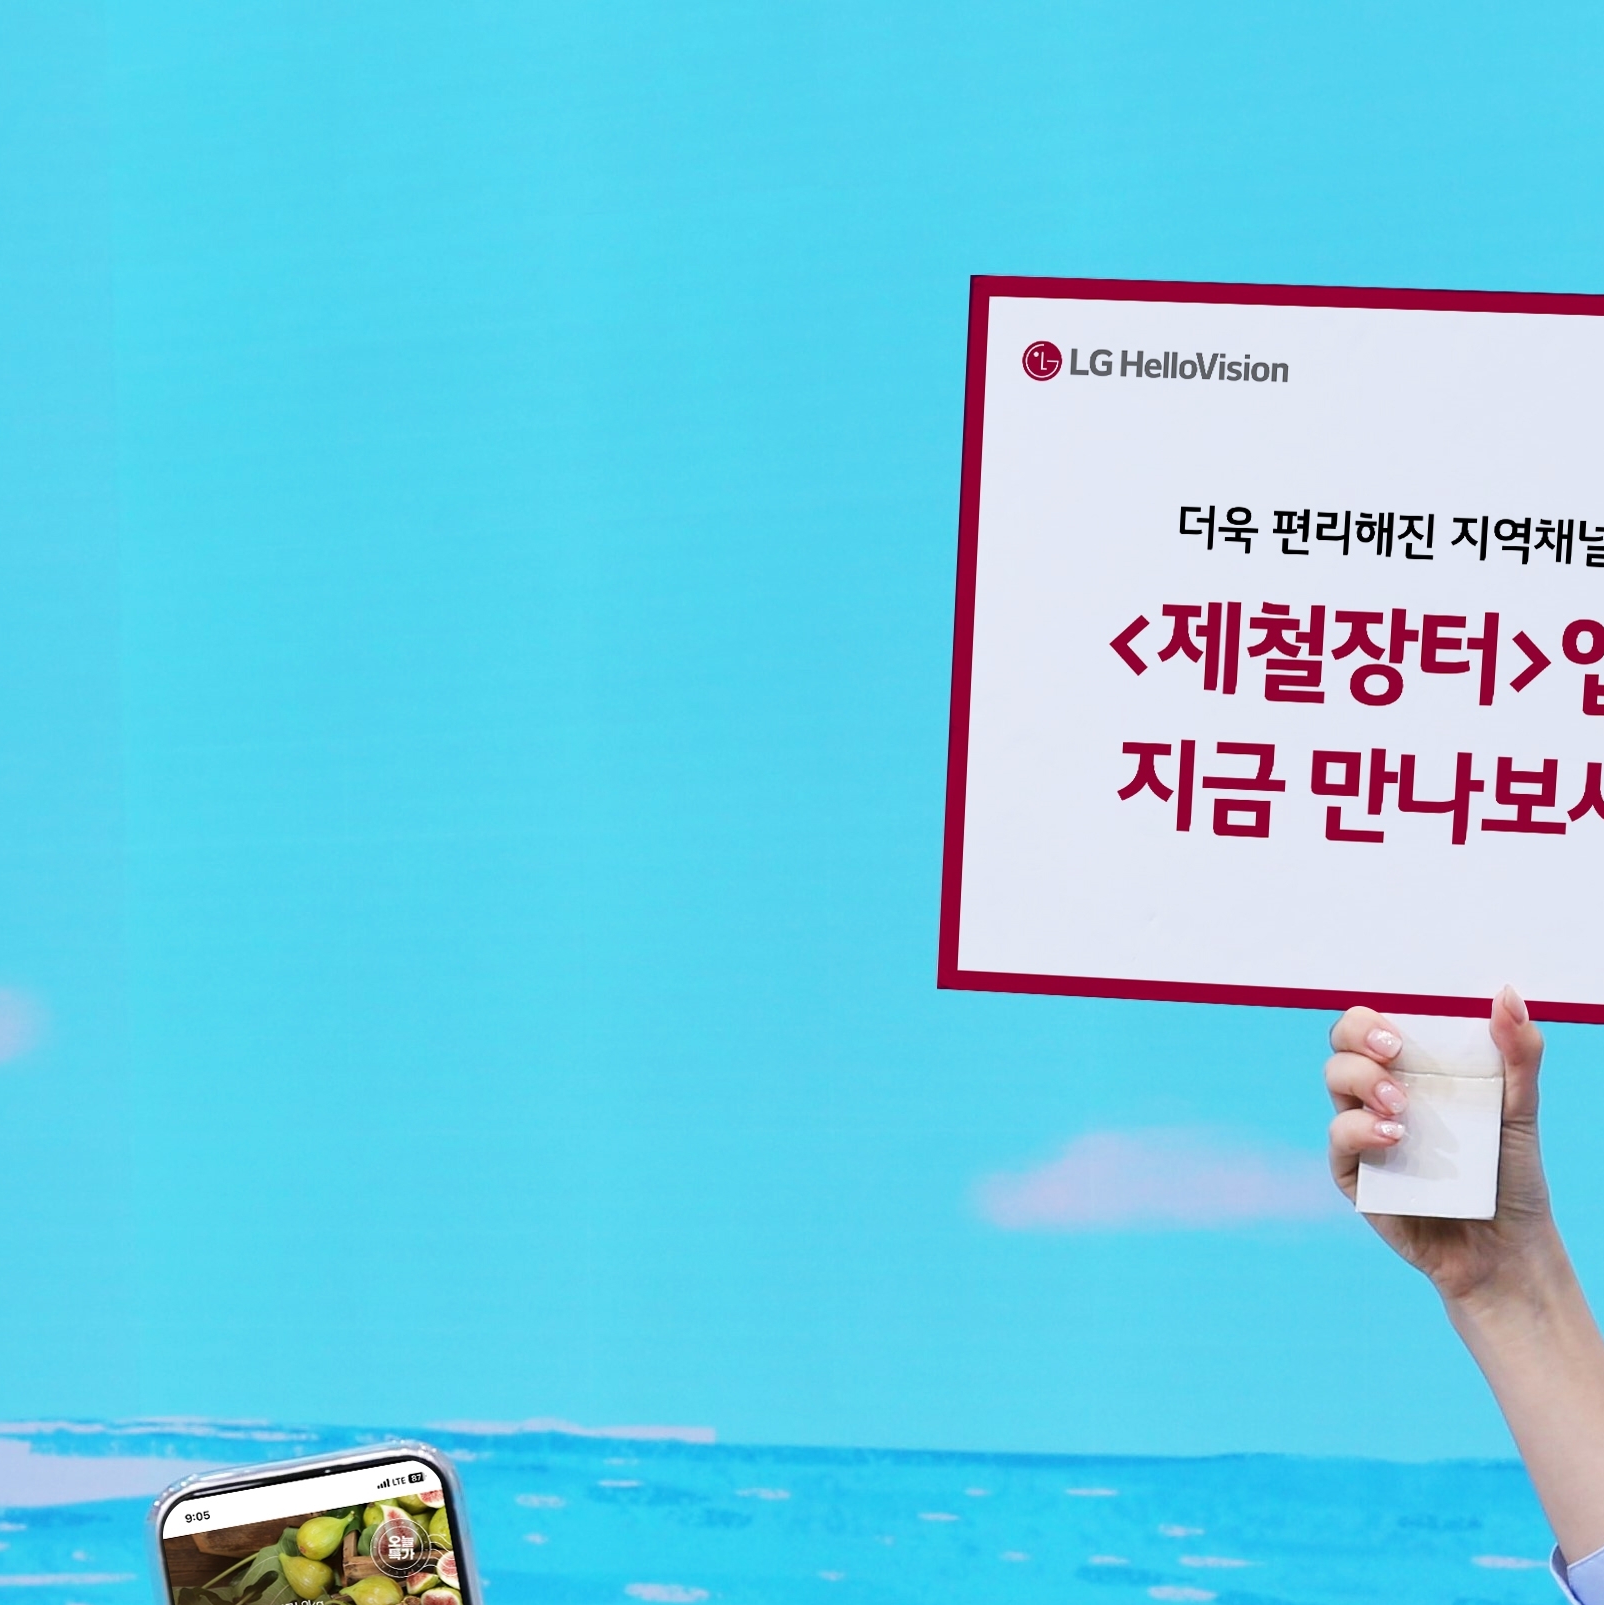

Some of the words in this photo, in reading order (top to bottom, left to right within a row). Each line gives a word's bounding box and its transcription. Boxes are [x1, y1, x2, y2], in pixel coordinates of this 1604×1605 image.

[1070, 348, 1113, 376] LG
[1120, 350, 1289, 382] HelloVision
[1178, 504, 1258, 554] 더욱
[1272, 509, 1434, 560] 편리해진
[1116, 738, 1286, 840] 지금
[392, 1477, 406, 1486] LTE
[410, 1473, 422, 1482] 87
[185, 1510, 210, 1523] 9:05
[388, 1535, 414, 1548] 오늘
[388, 1548, 415, 1560] 특가
